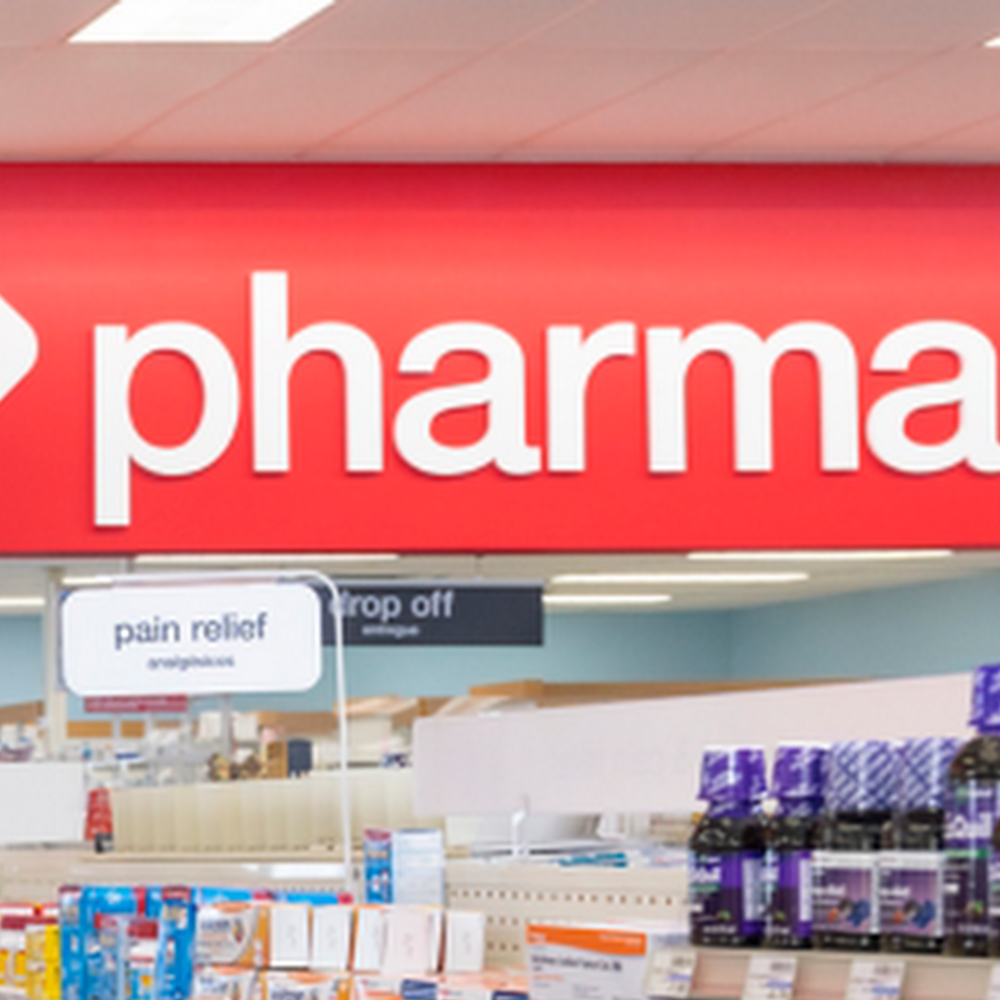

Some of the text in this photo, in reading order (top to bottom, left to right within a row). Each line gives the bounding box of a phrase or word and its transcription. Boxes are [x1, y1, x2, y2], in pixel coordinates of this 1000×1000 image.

[93, 270, 1000, 527] pharma
[410, 590, 455, 618] off
[114, 611, 268, 651] pain relief
